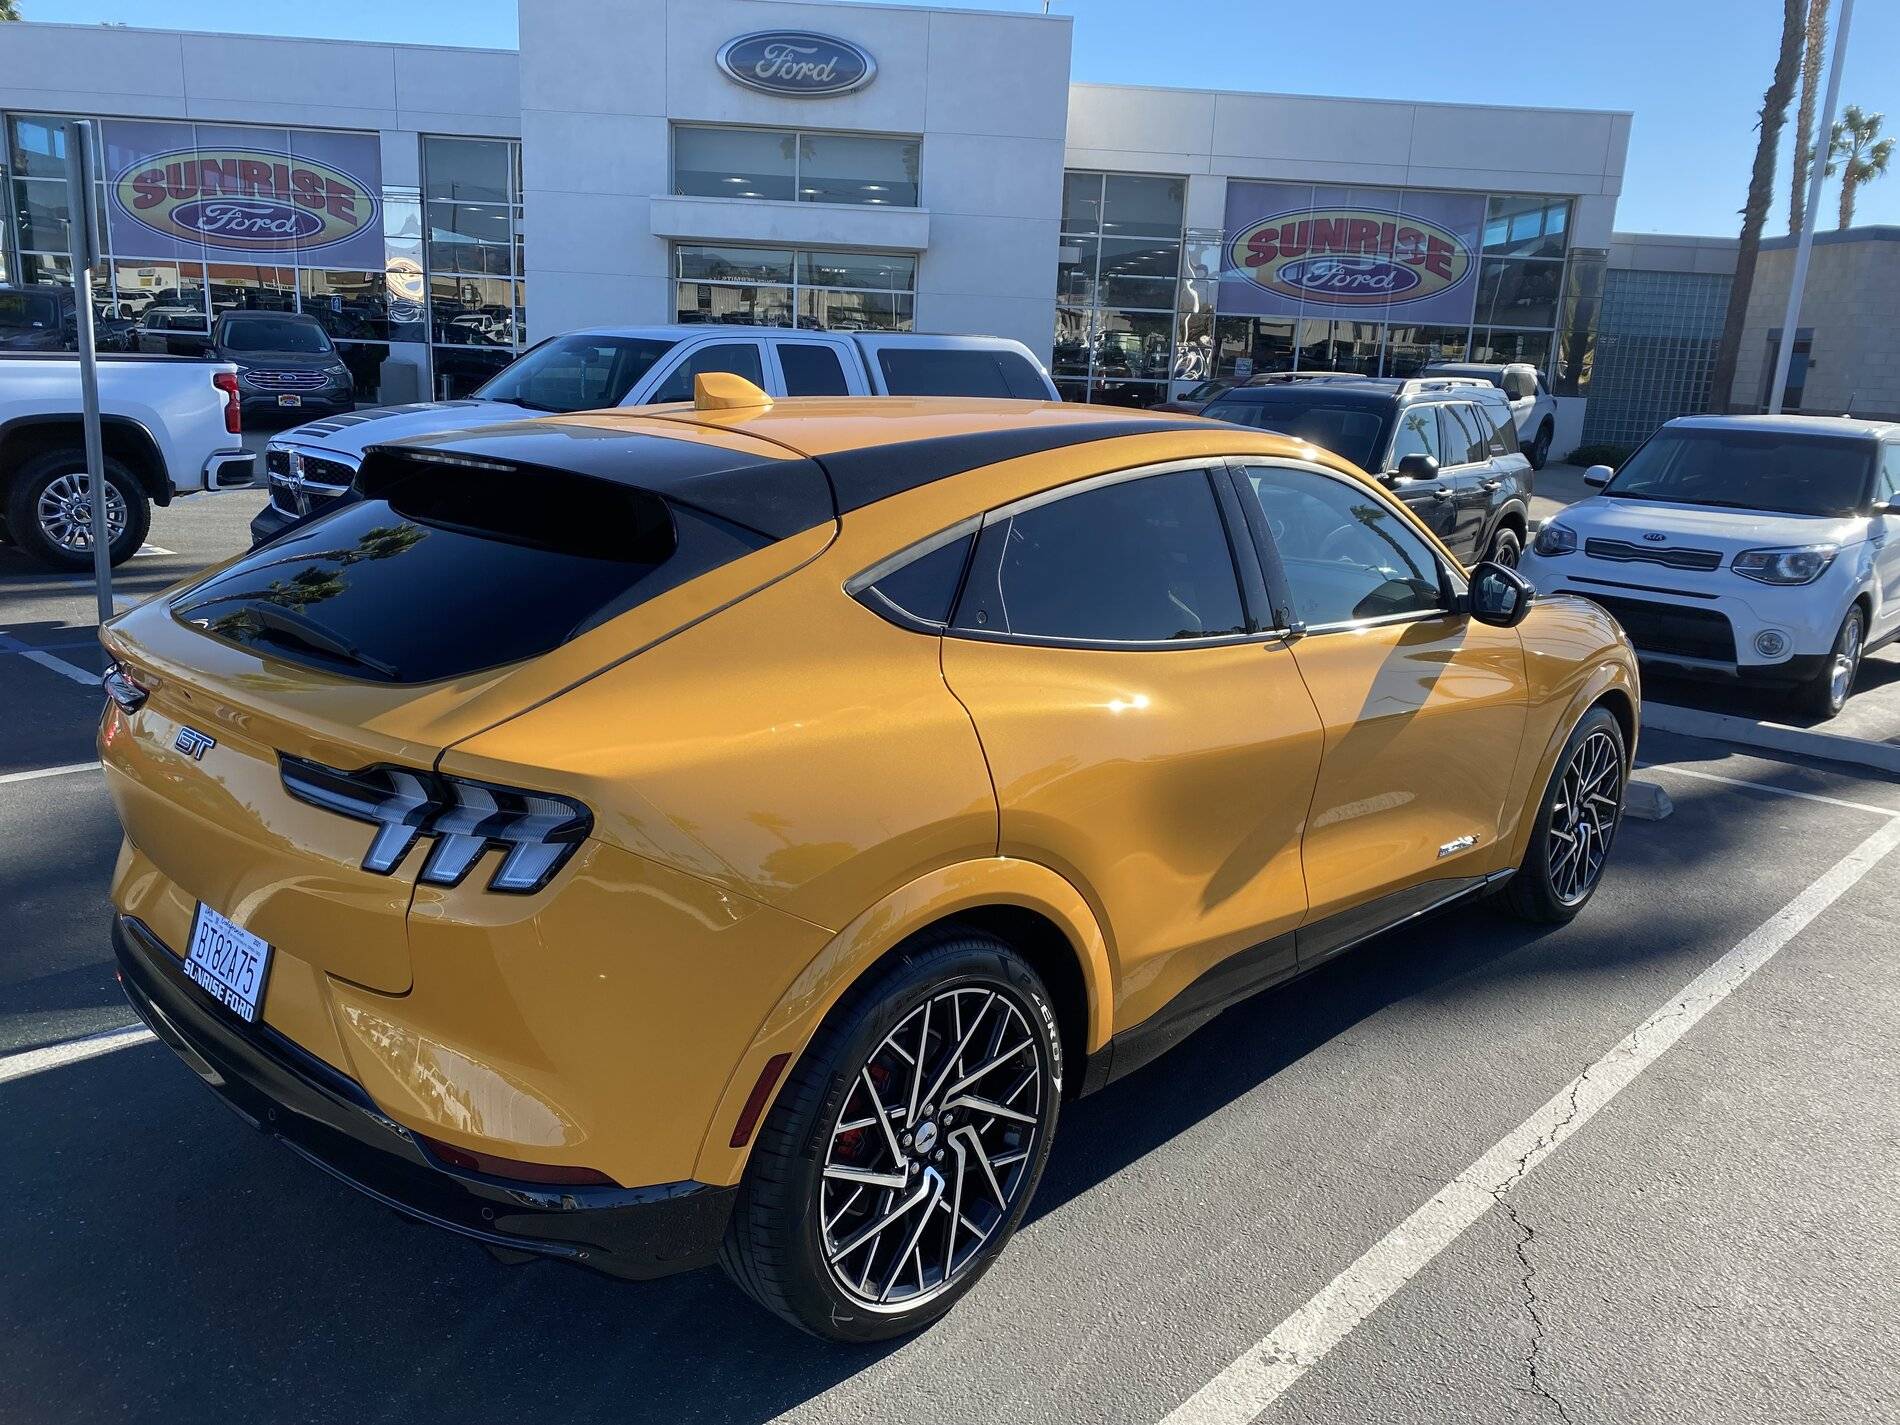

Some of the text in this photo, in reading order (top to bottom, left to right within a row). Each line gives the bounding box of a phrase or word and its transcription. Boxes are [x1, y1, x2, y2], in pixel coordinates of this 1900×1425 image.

[755, 43, 839, 82] Ford
[132, 158, 357, 227] SUNRISE
[197, 204, 298, 233] Ford
[1244, 217, 1455, 282] SUNRISE
[1302, 262, 1396, 289] Ford
[175, 724, 217, 761] GT
[196, 921, 258, 995] BT82A75
[183, 958, 256, 1023] SUNRISE FORD
